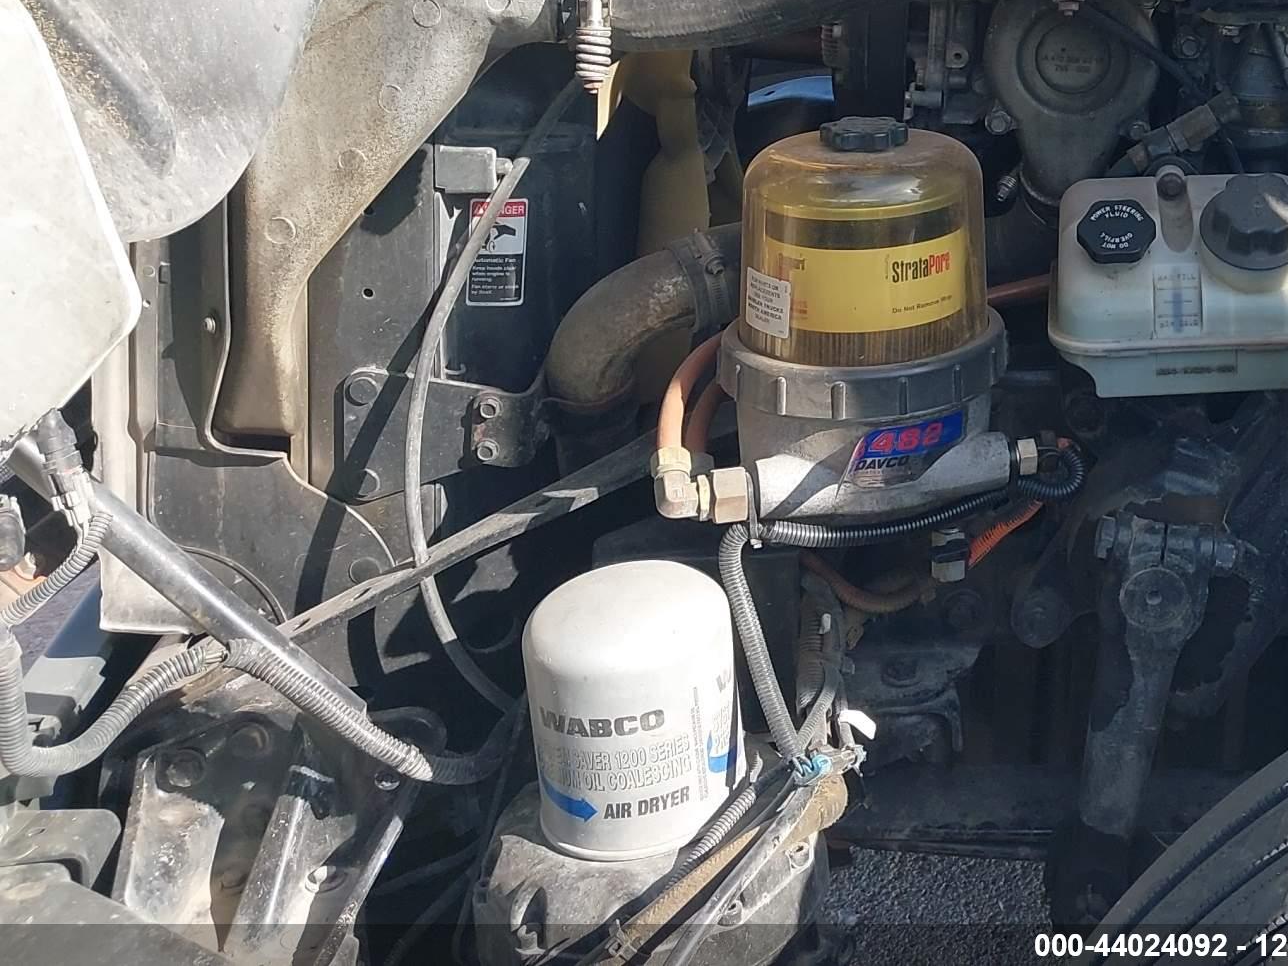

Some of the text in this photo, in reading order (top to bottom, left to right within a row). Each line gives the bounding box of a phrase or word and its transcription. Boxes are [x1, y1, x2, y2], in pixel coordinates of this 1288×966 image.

[1090, 205, 1145, 222] POWER STEERING
[1104, 211, 1129, 219] FLUID
[1100, 232, 1133, 243] OVERFILL
[1102, 241, 1129, 250] DO NOT
[891, 251, 951, 284] StrataPore
[916, 299, 940, 310] Remove
[854, 455, 911, 471] DAVCO
[539, 706, 665, 738] WABCO
[574, 751, 612, 772] SAVER
[614, 747, 647, 770] 1200
[649, 733, 691, 763] SERIES
[585, 771, 606, 792] OIL
[606, 754, 693, 791] COALESCING
[603, 785, 691, 820] AIR DRYER
